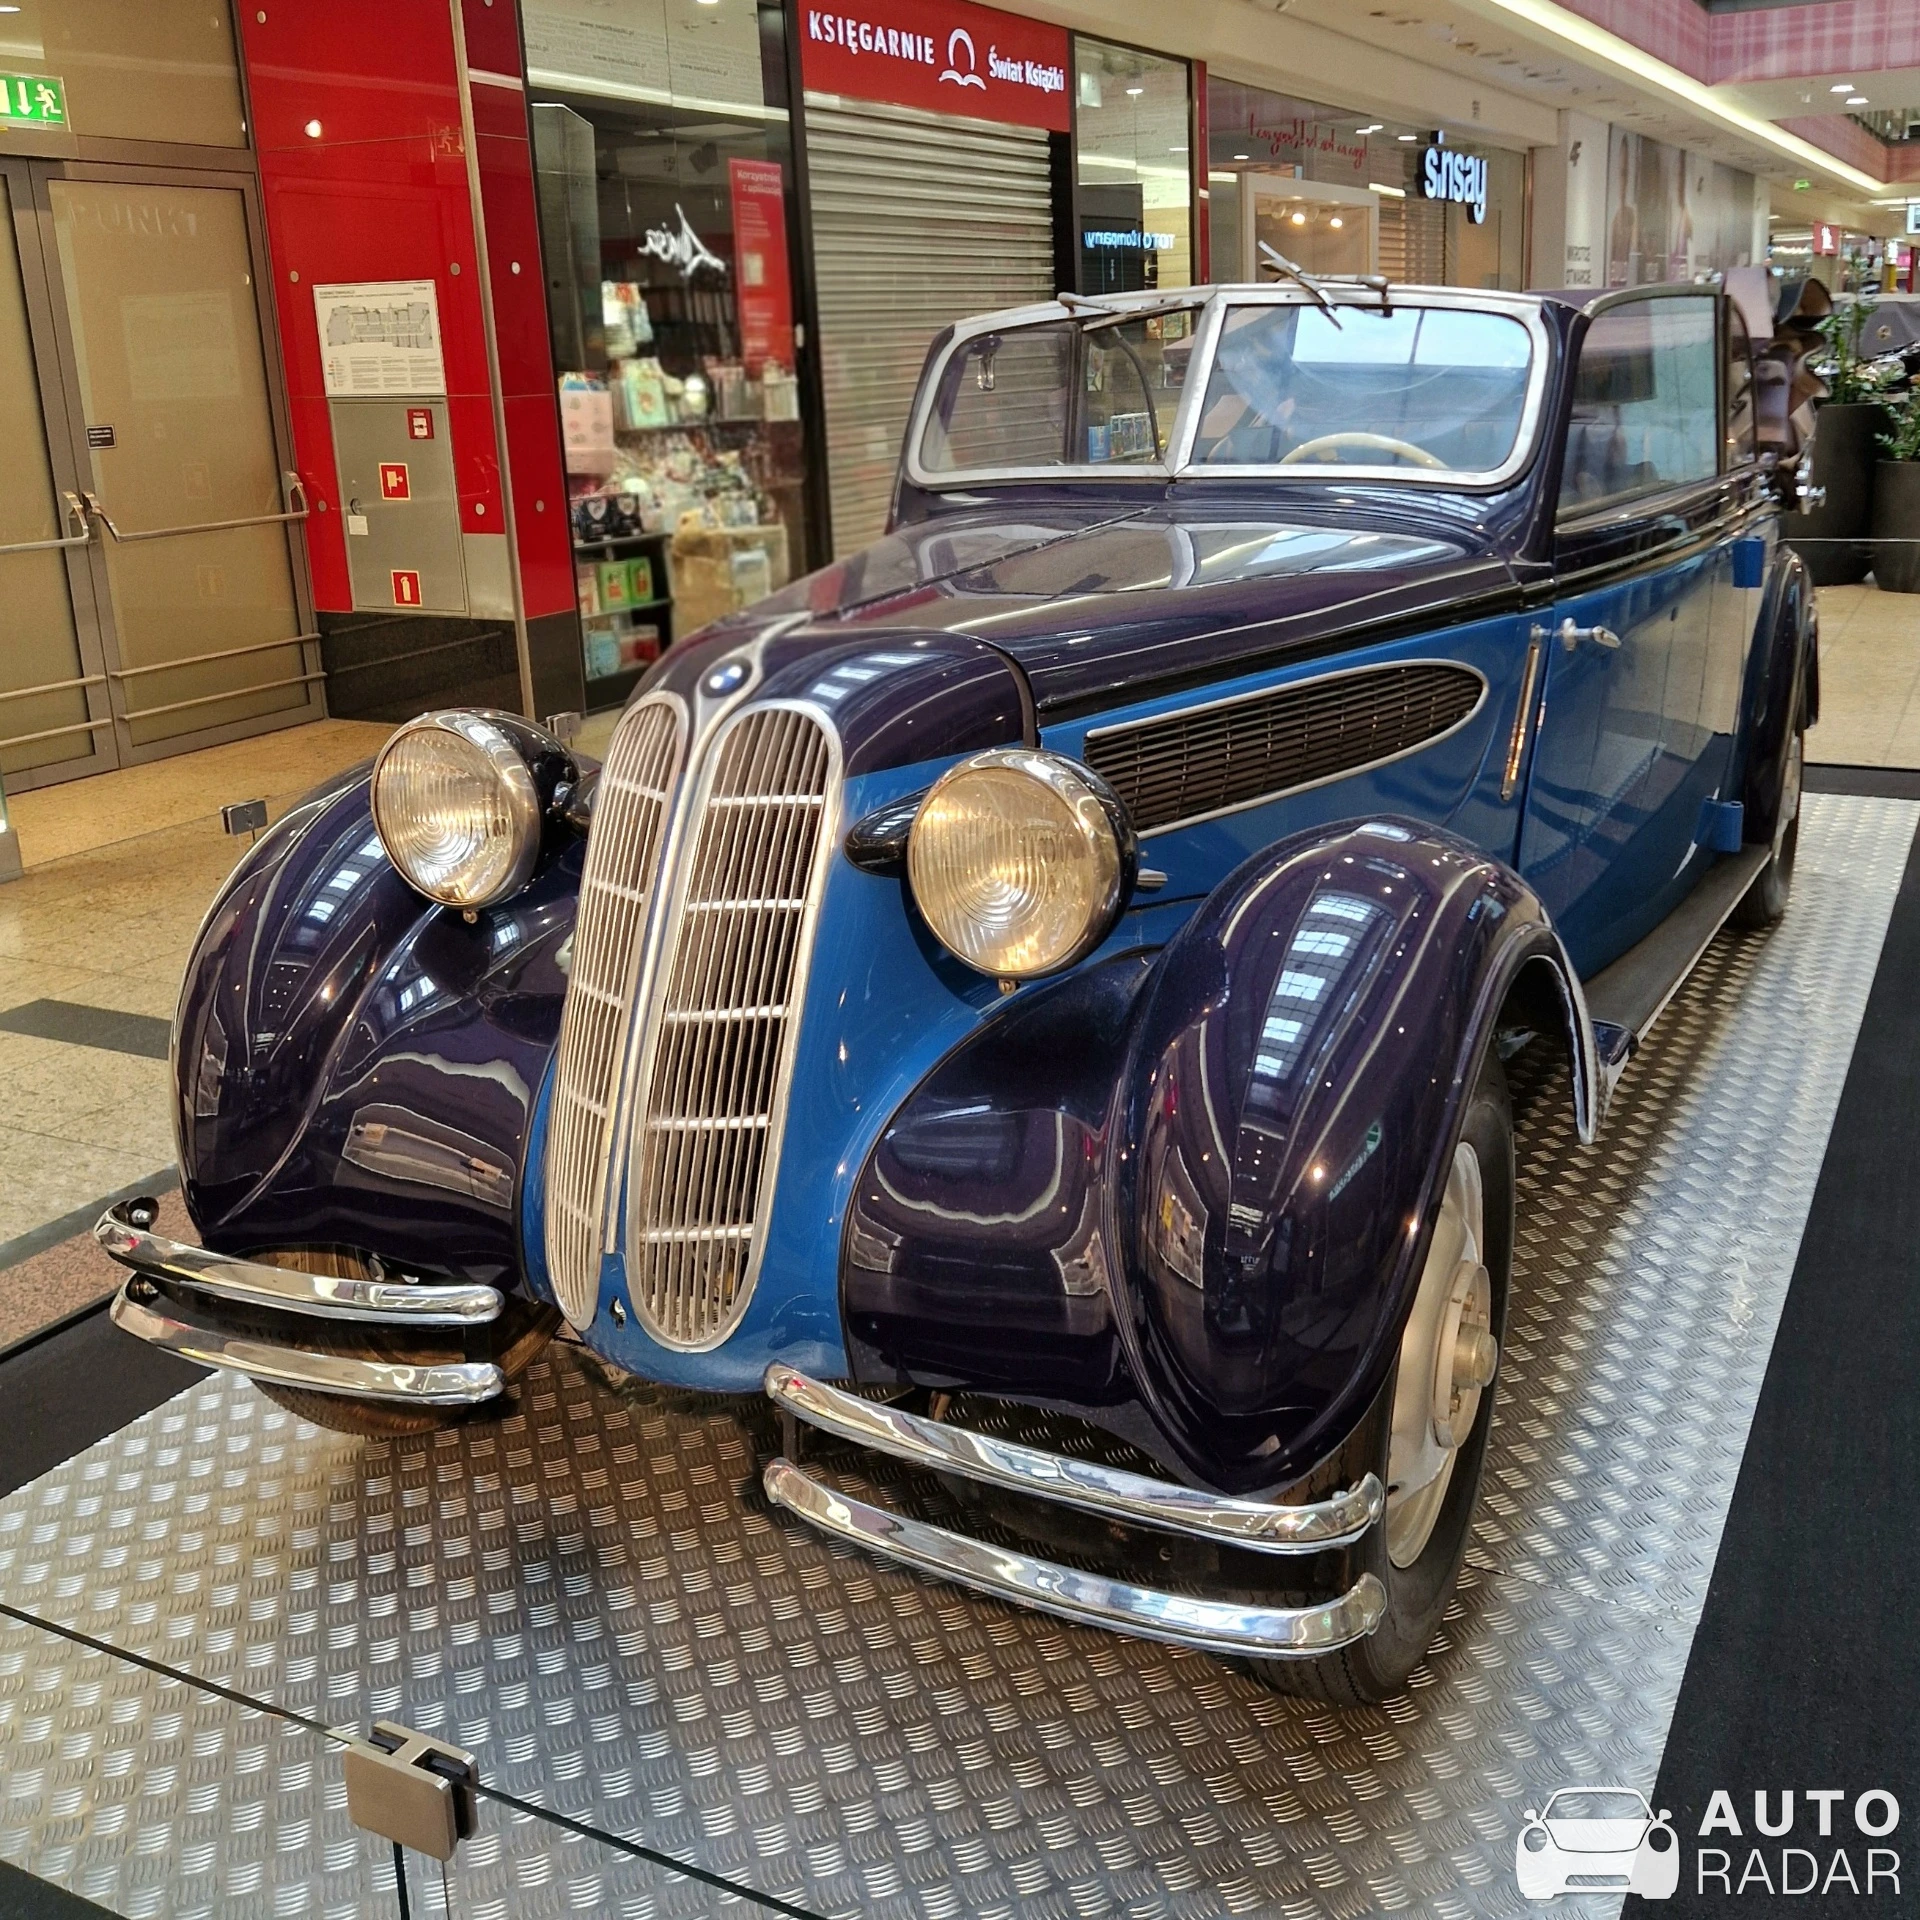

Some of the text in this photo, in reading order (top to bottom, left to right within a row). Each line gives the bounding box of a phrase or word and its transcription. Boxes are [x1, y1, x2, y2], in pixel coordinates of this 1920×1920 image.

[809, 10, 935, 65] KSIĘGARNIE
[988, 44, 1064, 93] Świat Książki
[1424, 130, 1488, 225] sinsay
